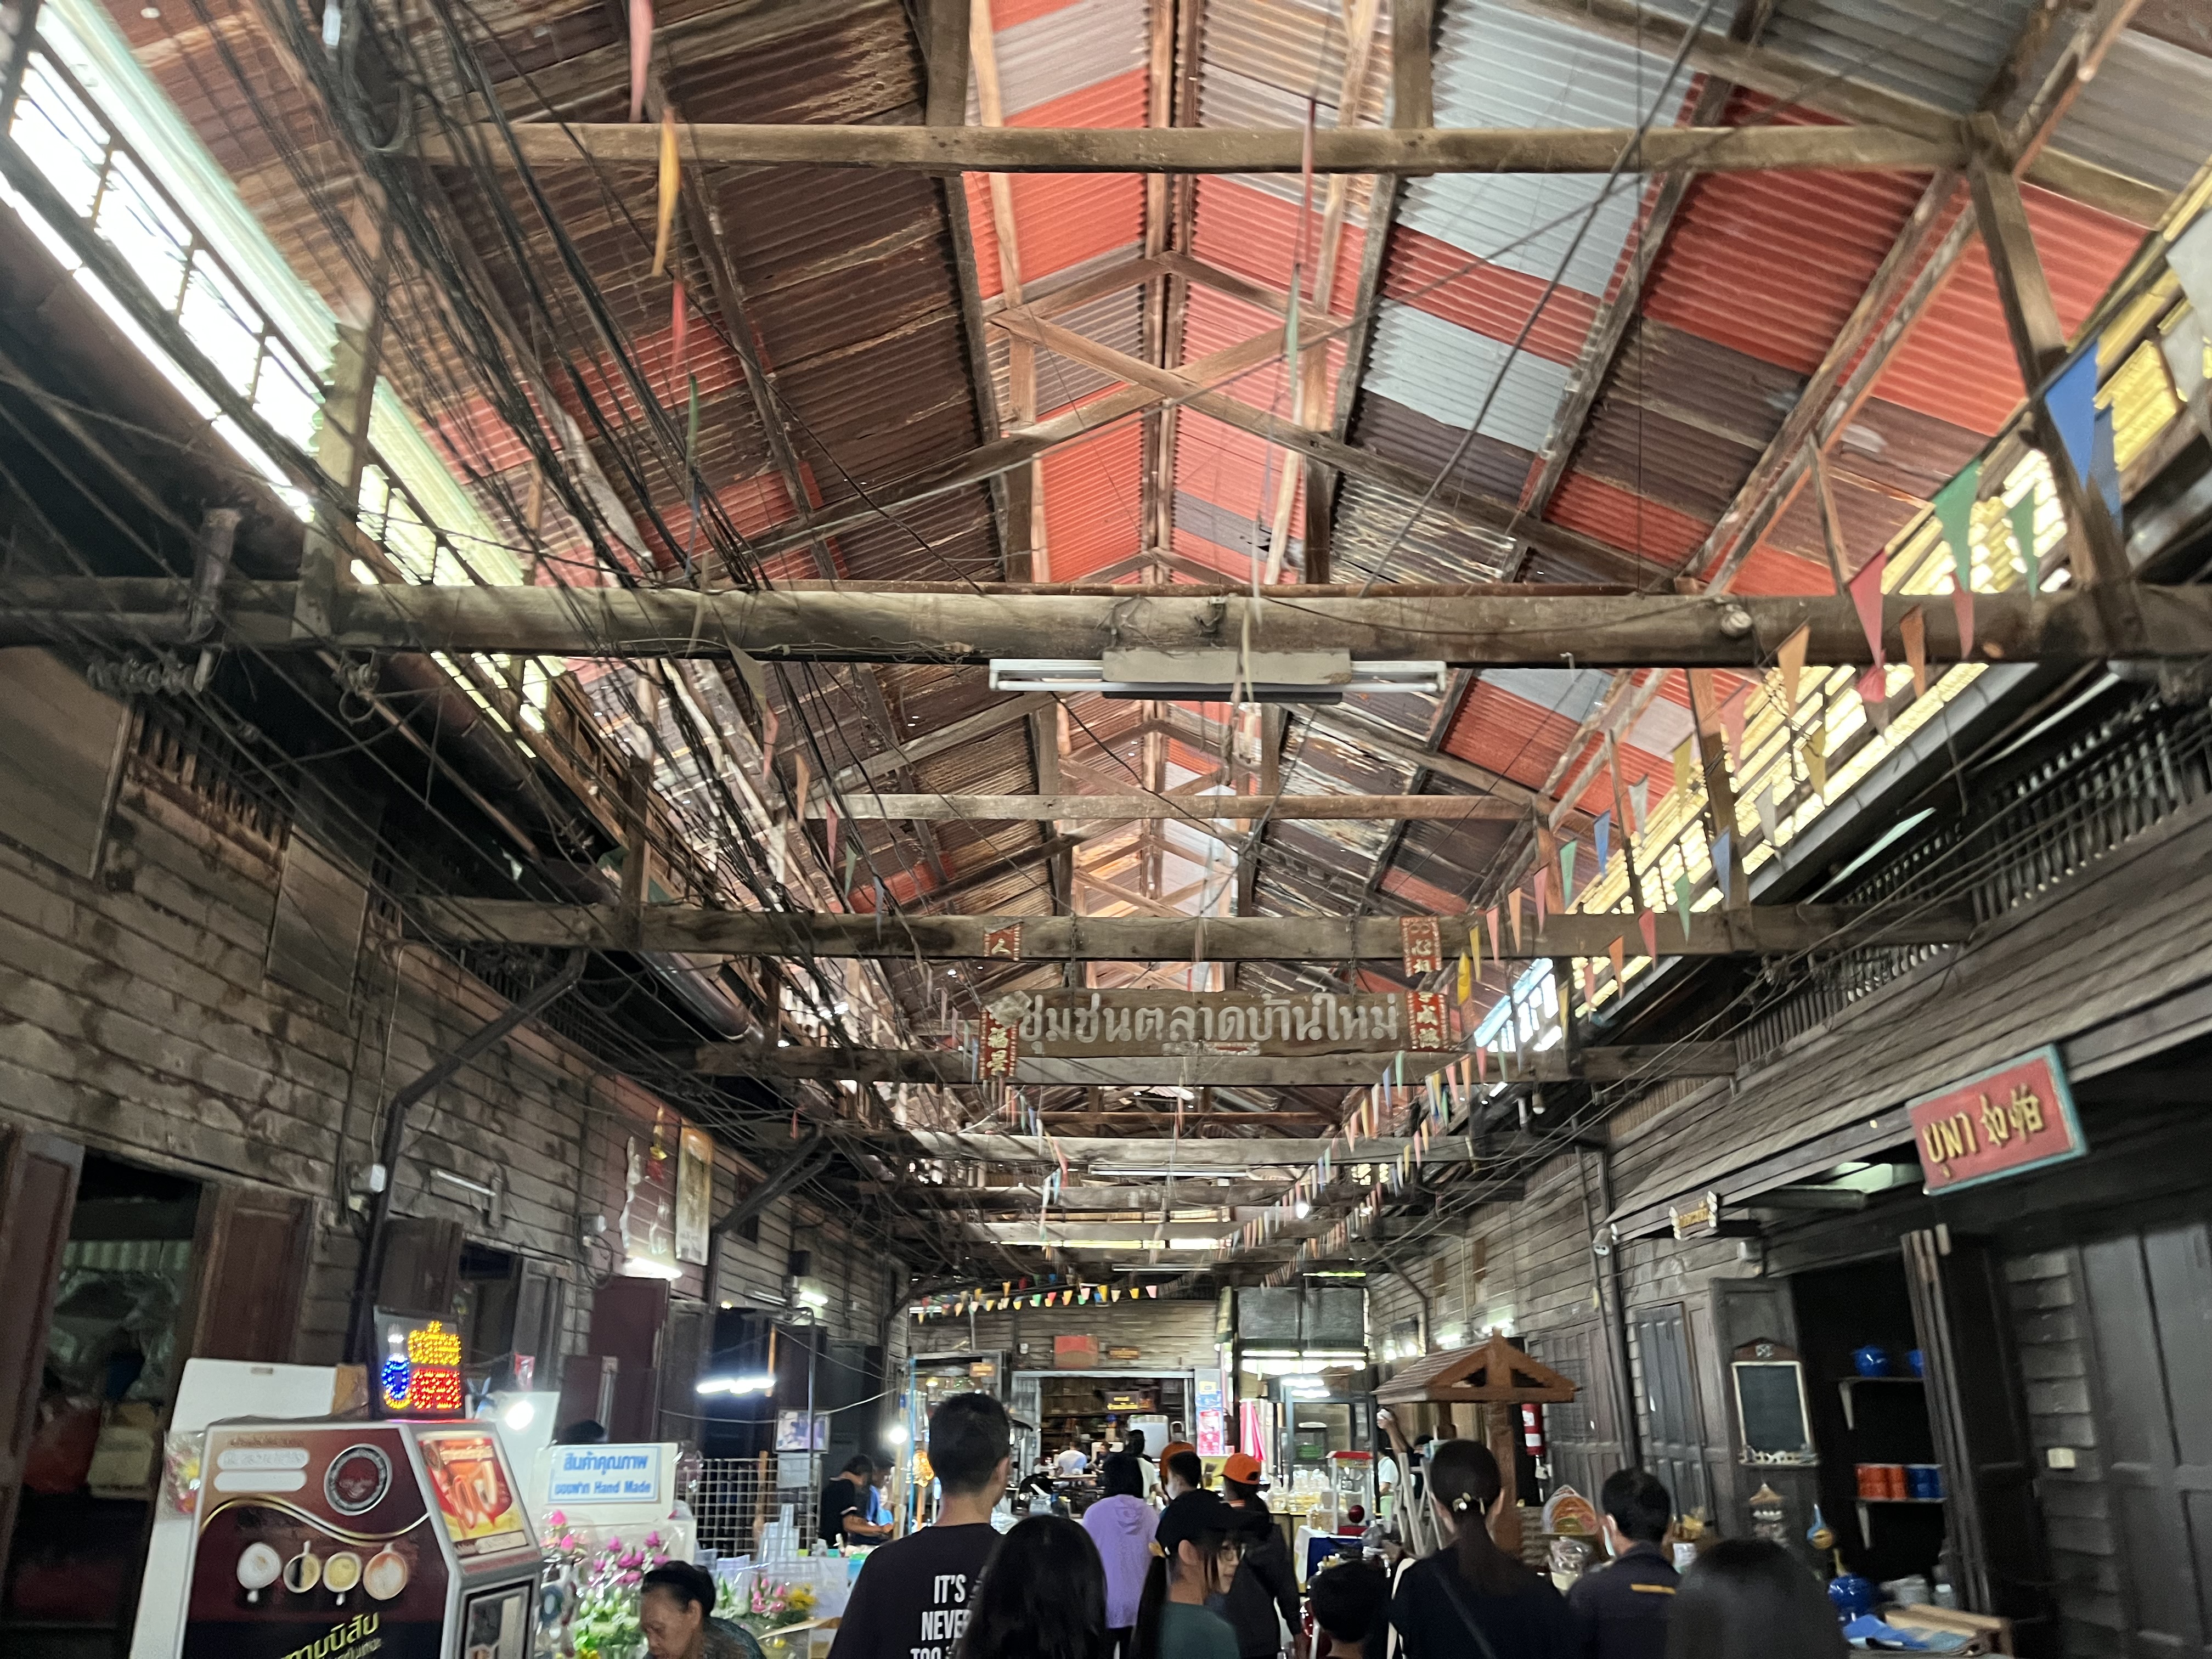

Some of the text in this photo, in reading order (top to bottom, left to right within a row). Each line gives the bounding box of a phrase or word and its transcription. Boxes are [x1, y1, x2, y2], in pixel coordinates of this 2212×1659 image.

[593, 1480, 651, 1494] Hand Made
[934, 1574, 967, 1604] IT'S
